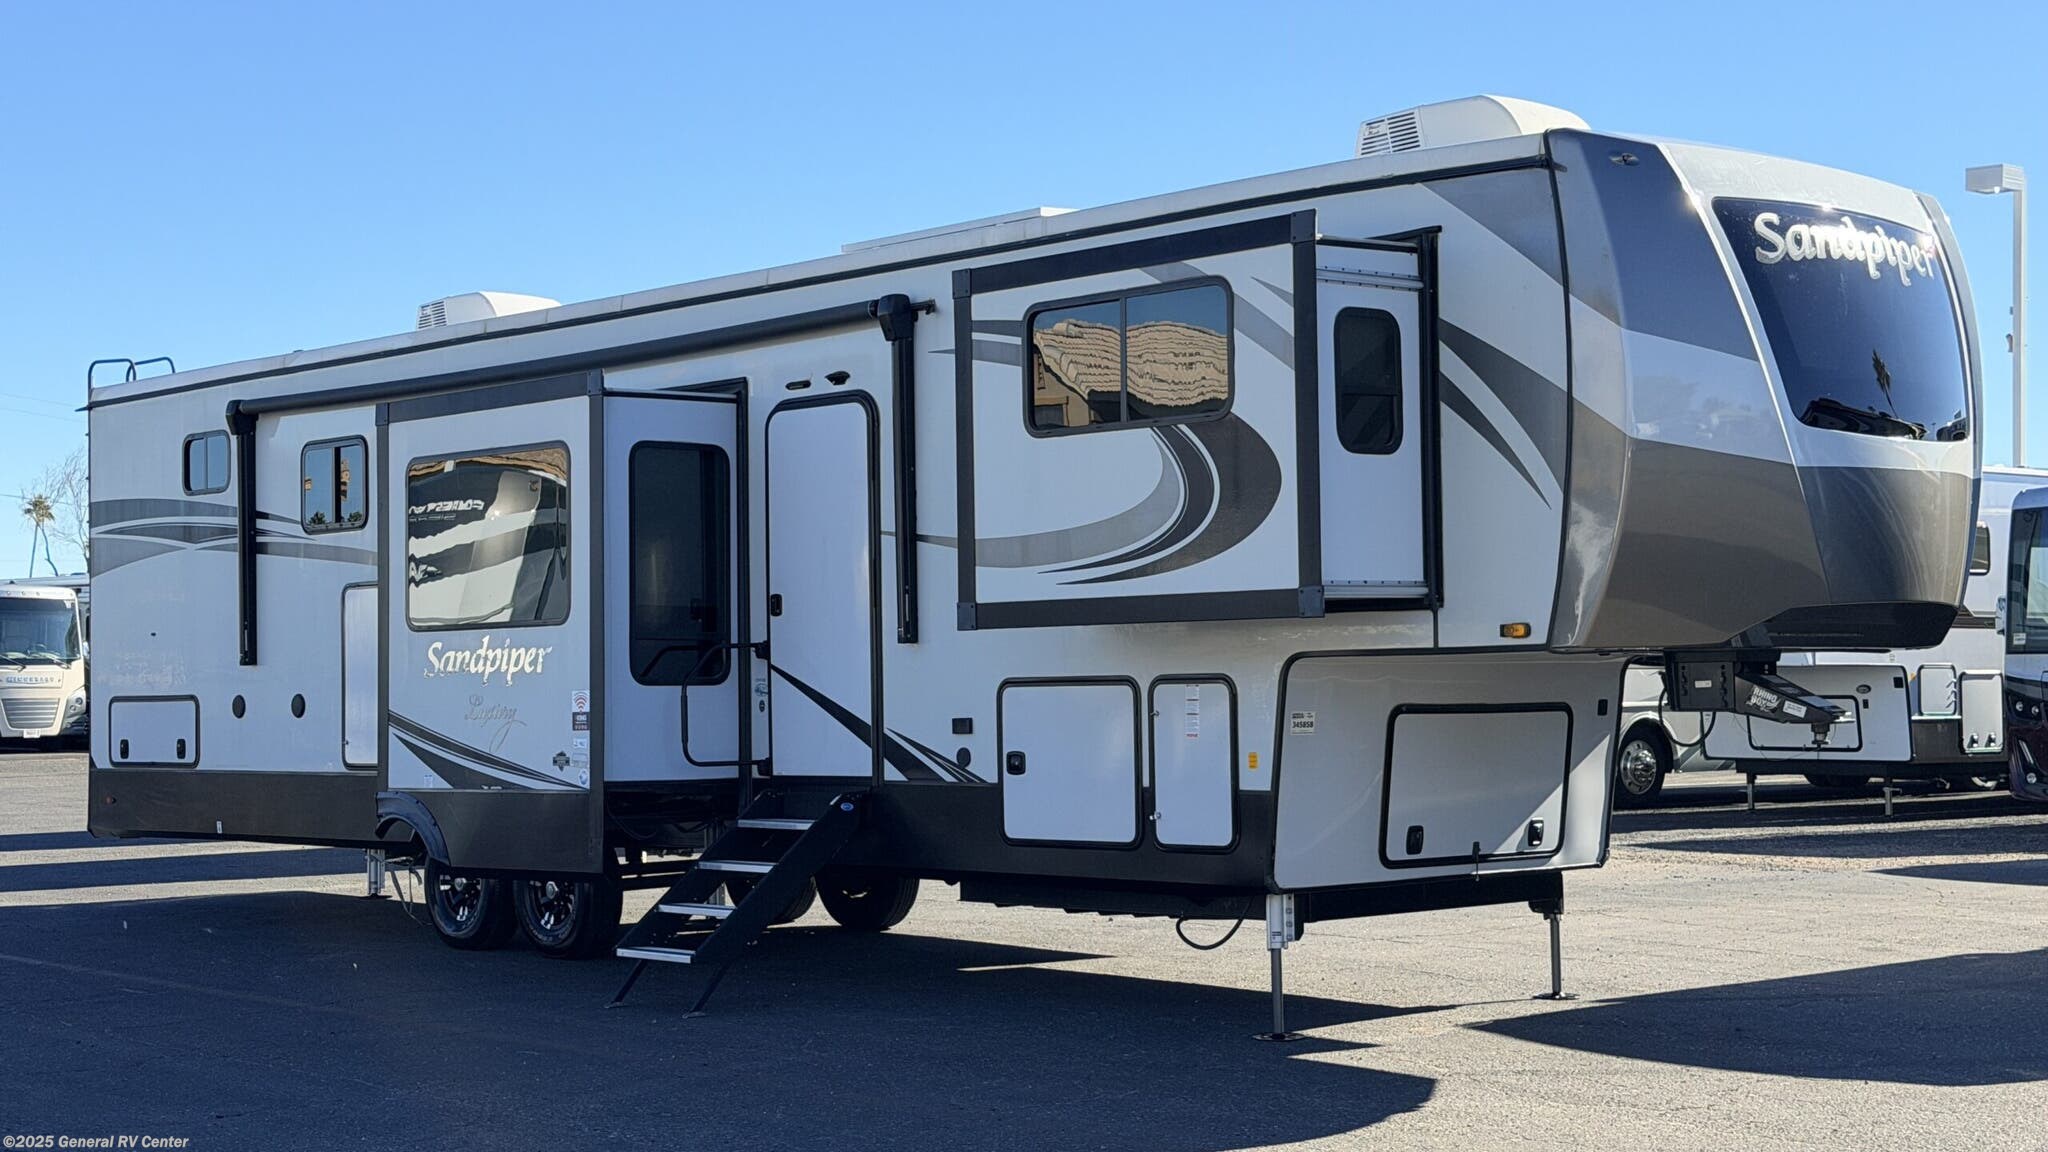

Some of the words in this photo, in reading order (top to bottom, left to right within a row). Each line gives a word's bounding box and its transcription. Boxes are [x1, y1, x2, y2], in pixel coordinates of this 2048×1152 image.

[1754, 212, 1937, 286] Sandpiper
[424, 634, 553, 688] Sandpiper
[1753, 686, 1778, 703] RHINO
